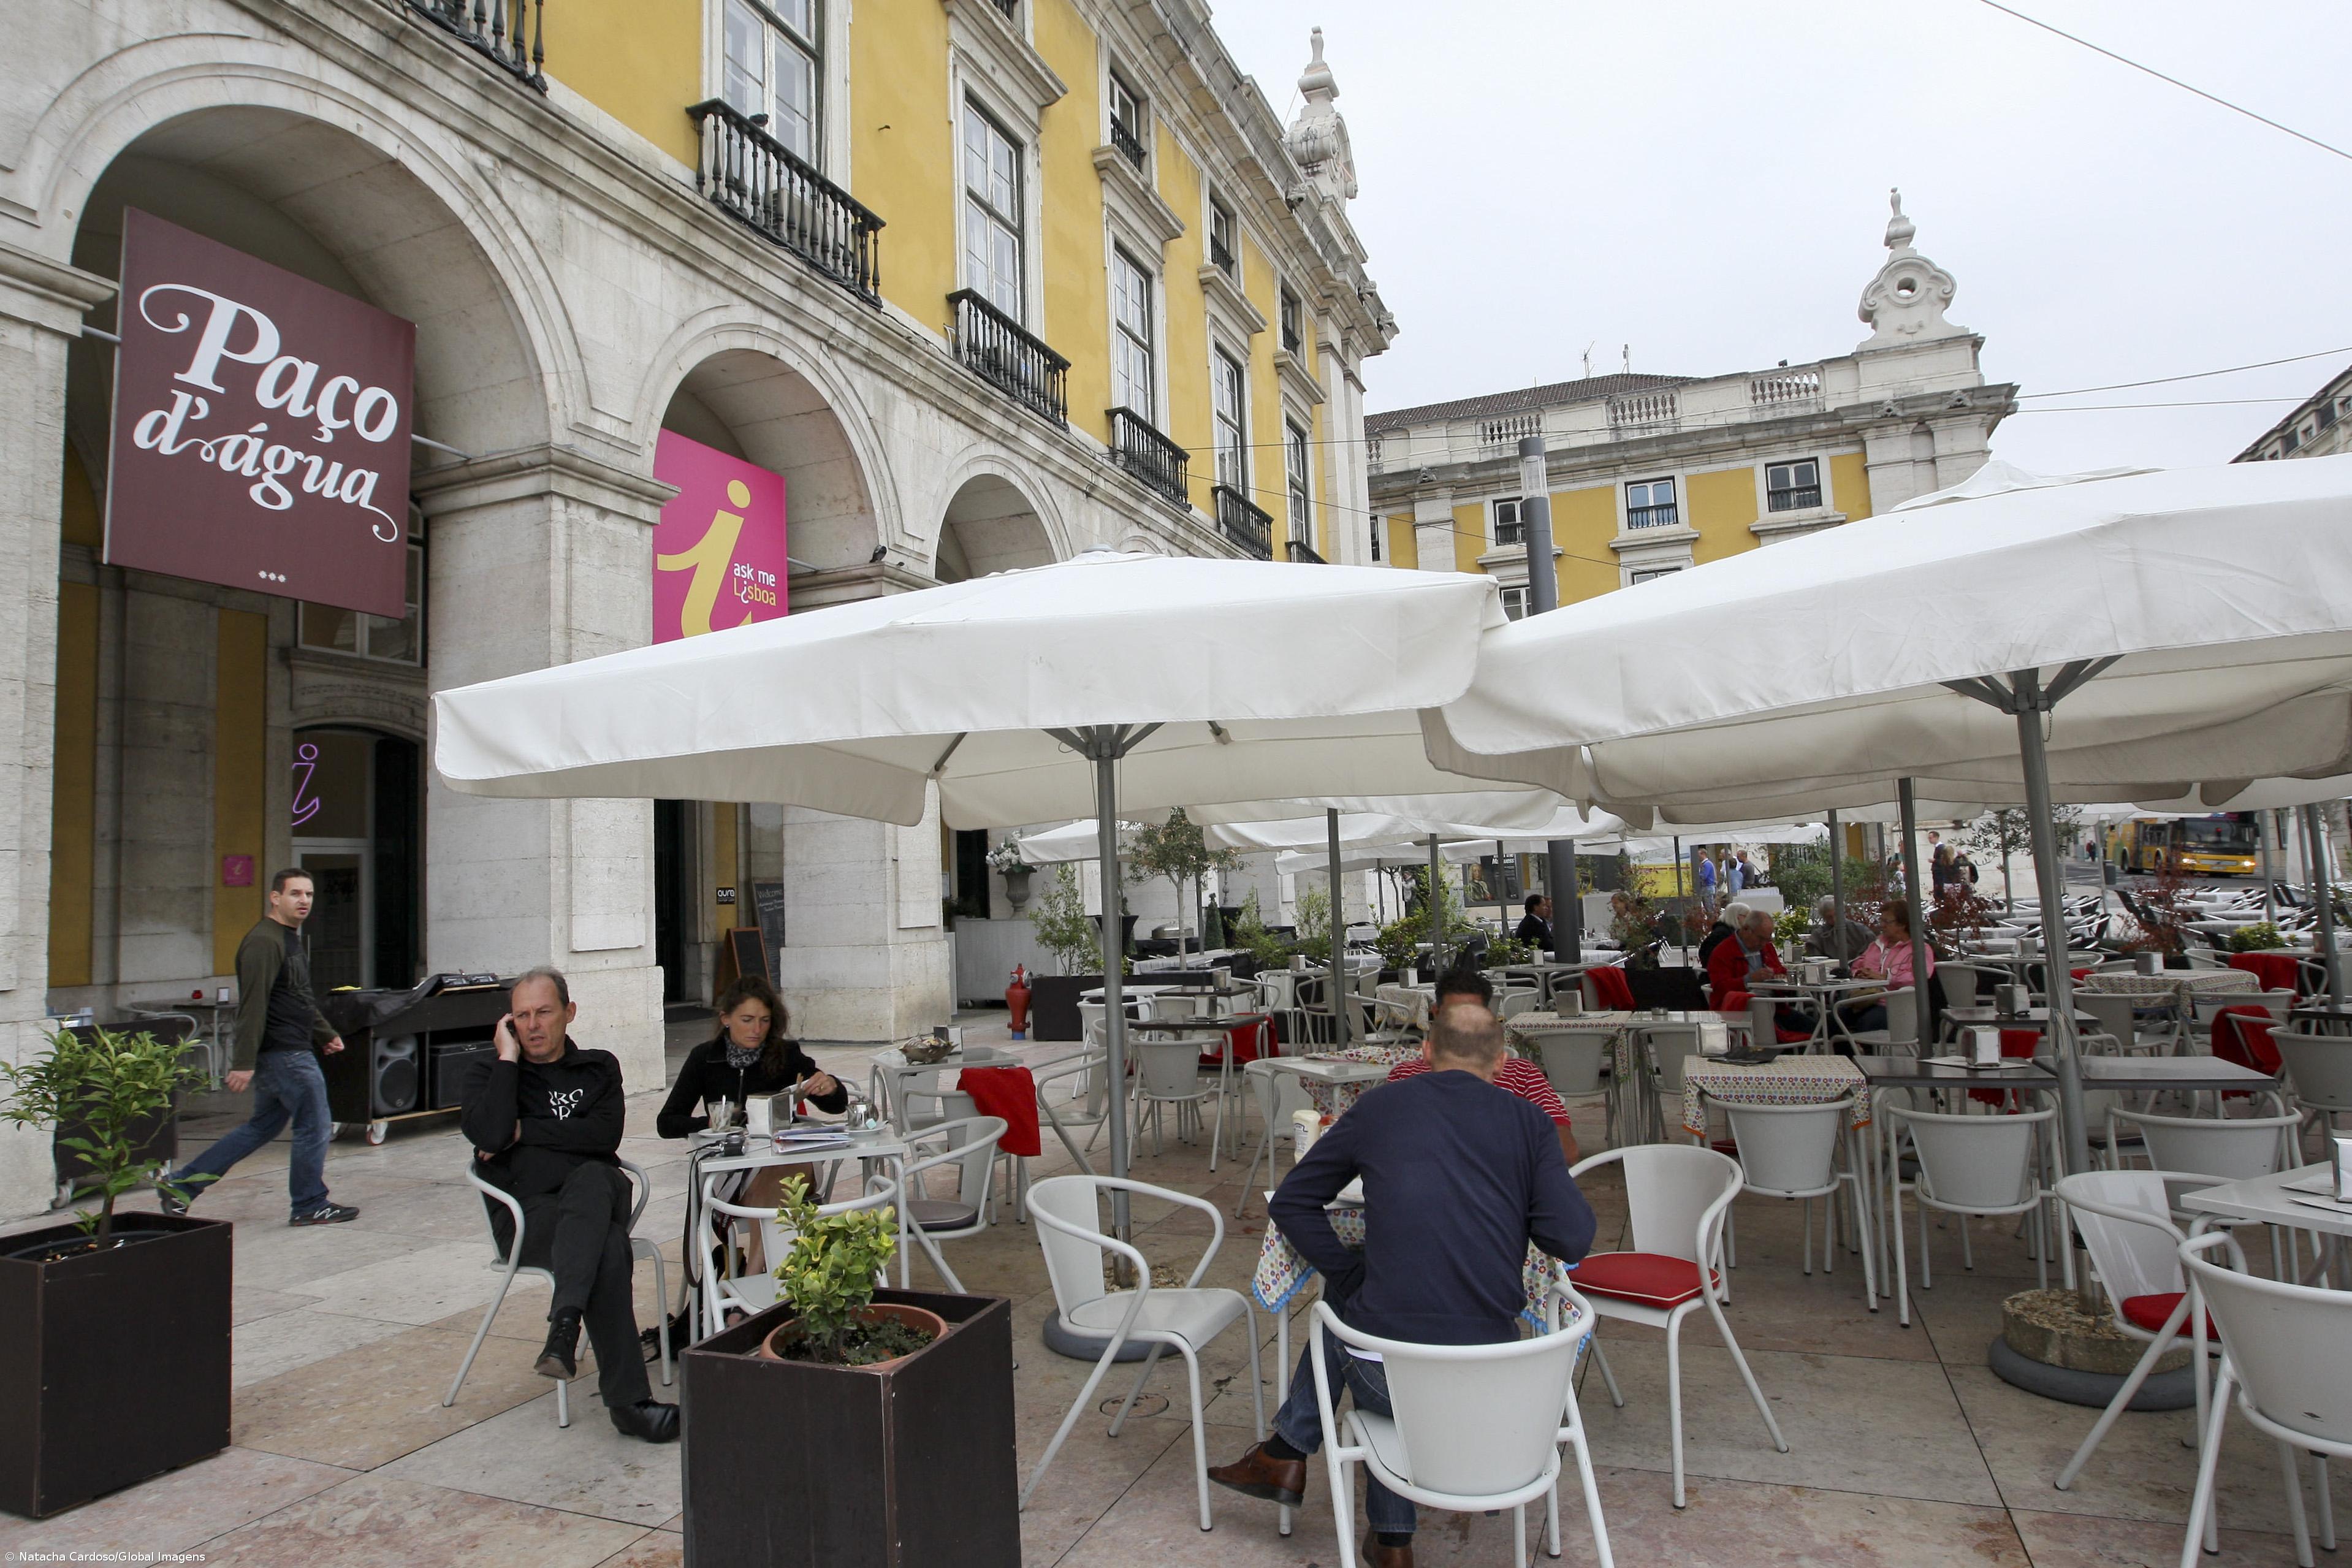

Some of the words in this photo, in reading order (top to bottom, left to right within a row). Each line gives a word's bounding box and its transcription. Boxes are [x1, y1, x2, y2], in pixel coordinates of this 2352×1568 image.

[139, 283, 399, 443] Paço
[132, 389, 399, 543] d'água
[733, 562, 754, 581] ask
[758, 569, 775, 587] me
[733, 579, 777, 607] Lisboa
